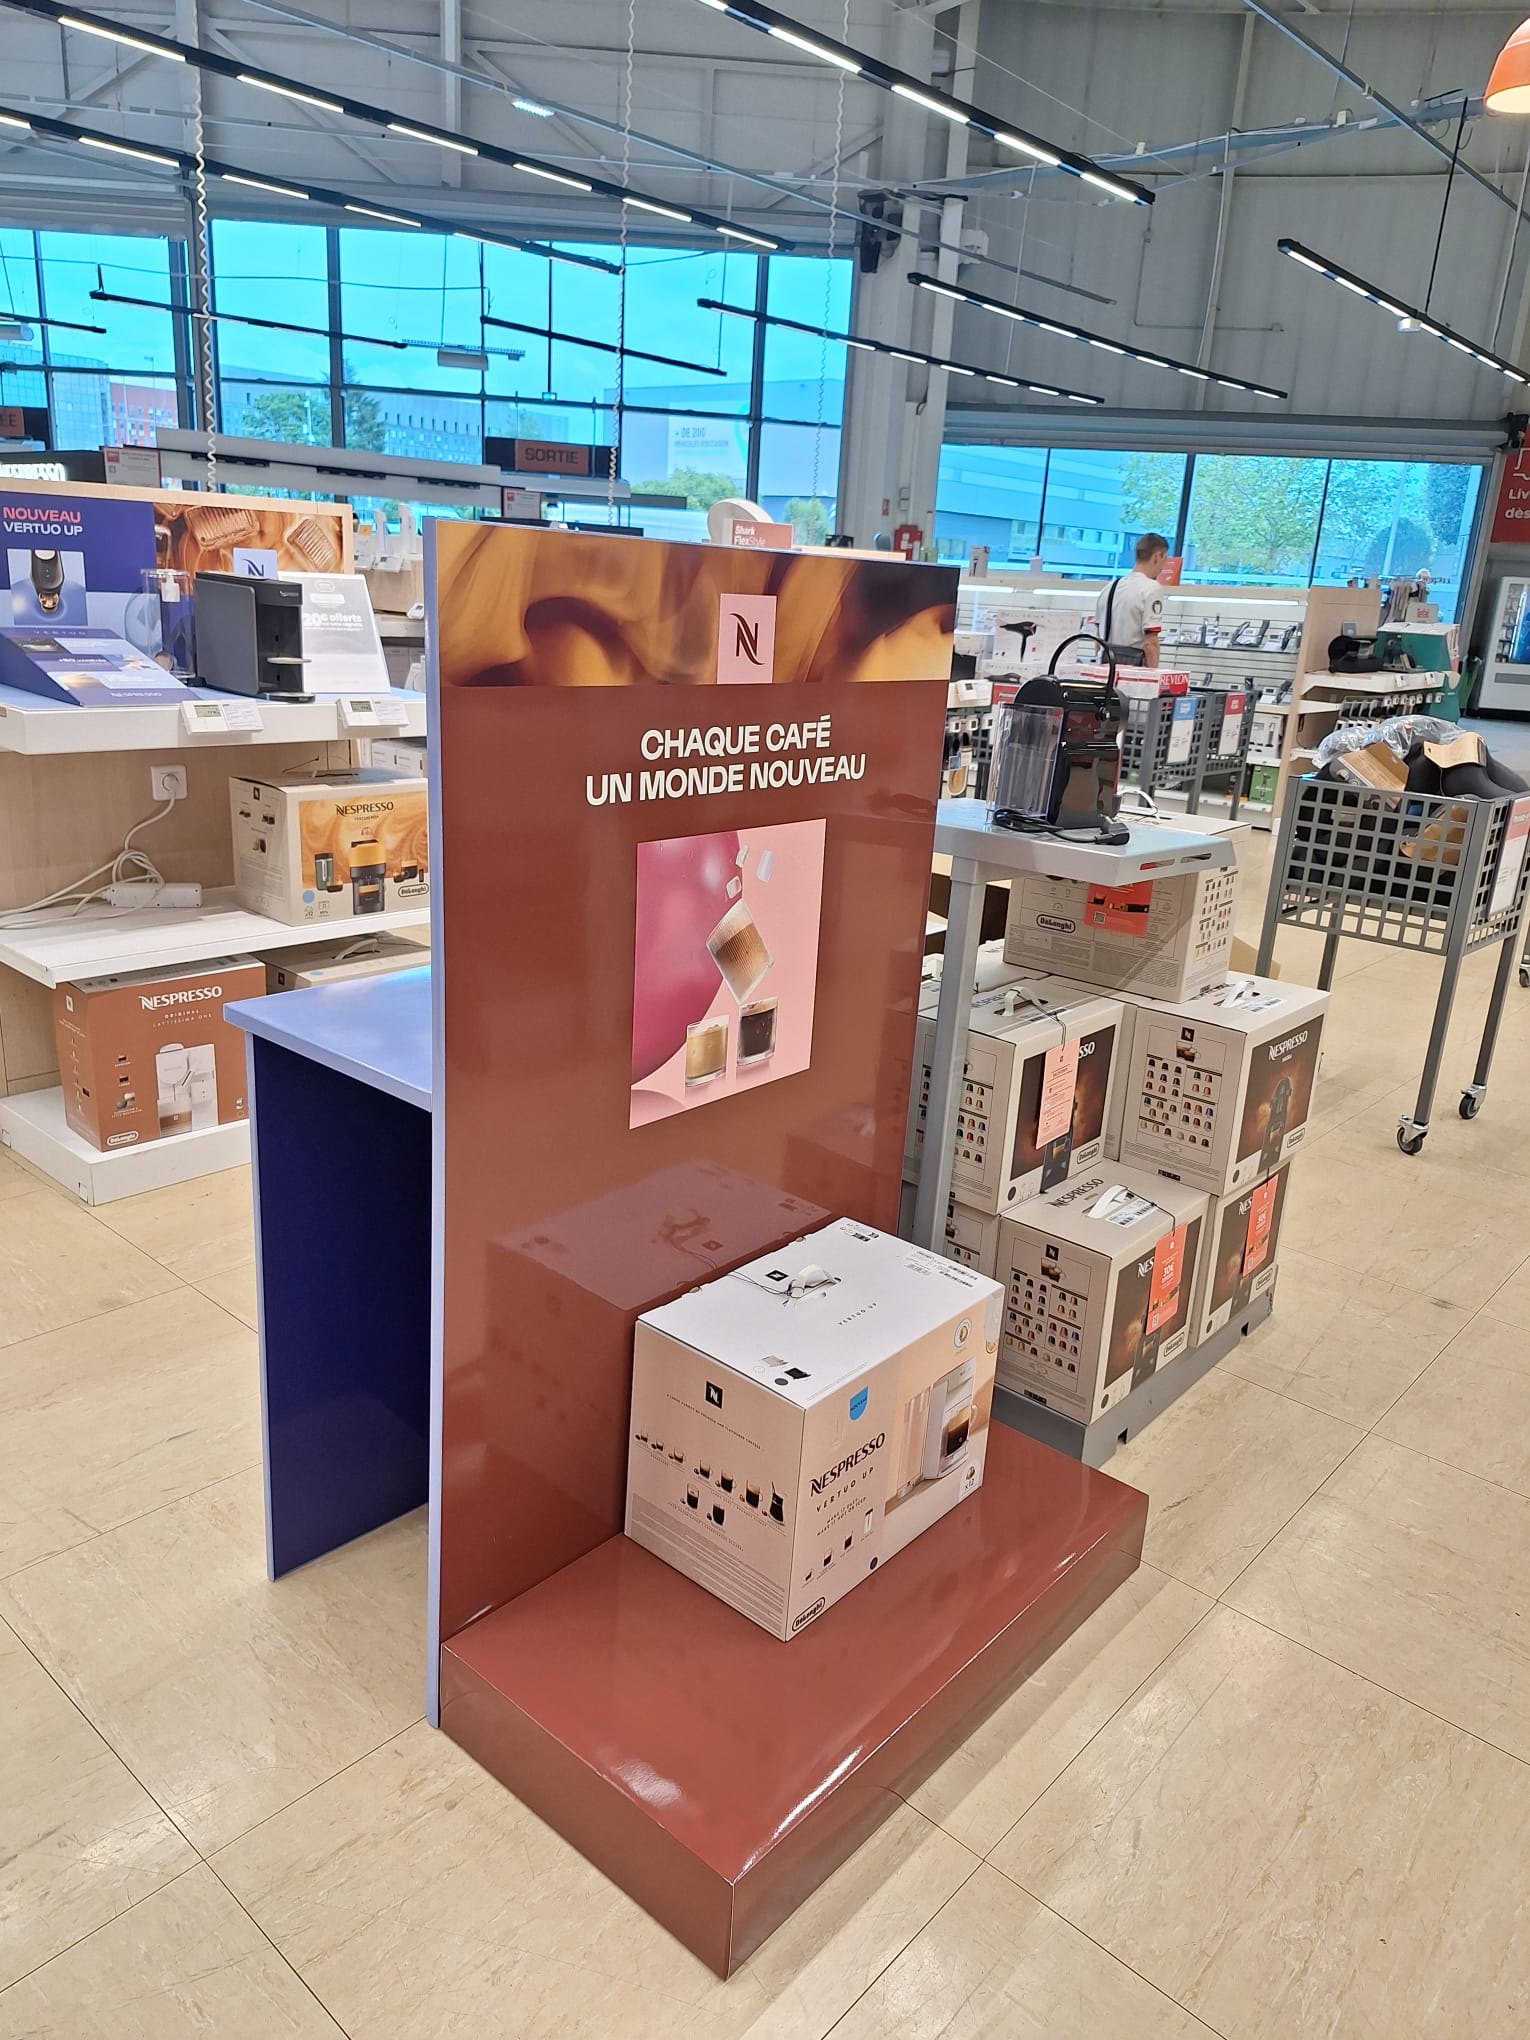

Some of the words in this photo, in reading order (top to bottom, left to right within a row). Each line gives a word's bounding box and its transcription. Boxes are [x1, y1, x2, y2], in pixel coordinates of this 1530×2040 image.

[524, 447, 579, 464] SORTIE
[3, 507, 81, 523] NOUVEAU
[3, 521, 61, 535] VERTUO
[64, 524, 83, 536] UP
[735, 524, 755, 536] Shark
[1160, 673, 1189, 686] REVLON
[641, 725, 760, 761] CHAQUE
[766, 714, 831, 752] CAFÉ
[586, 773, 632, 806] UN
[639, 764, 744, 801] MONDE
[750, 754, 866, 790] NOUVEAU
[336, 802, 394, 816] NESPRESSO
[138, 986, 222, 1010] NESPRESSO
[164, 1010, 199, 1019] ORIGINAL
[1269, 1031, 1308, 1060] NESPRESSO
[1047, 1178, 1104, 1208] NESPRESSO
[810, 1432, 885, 1496] NESPRESSO
[816, 1479, 857, 1512] VERTUO
[862, 1466, 874, 1480] UP
[964, 1478, 975, 1490] x12
